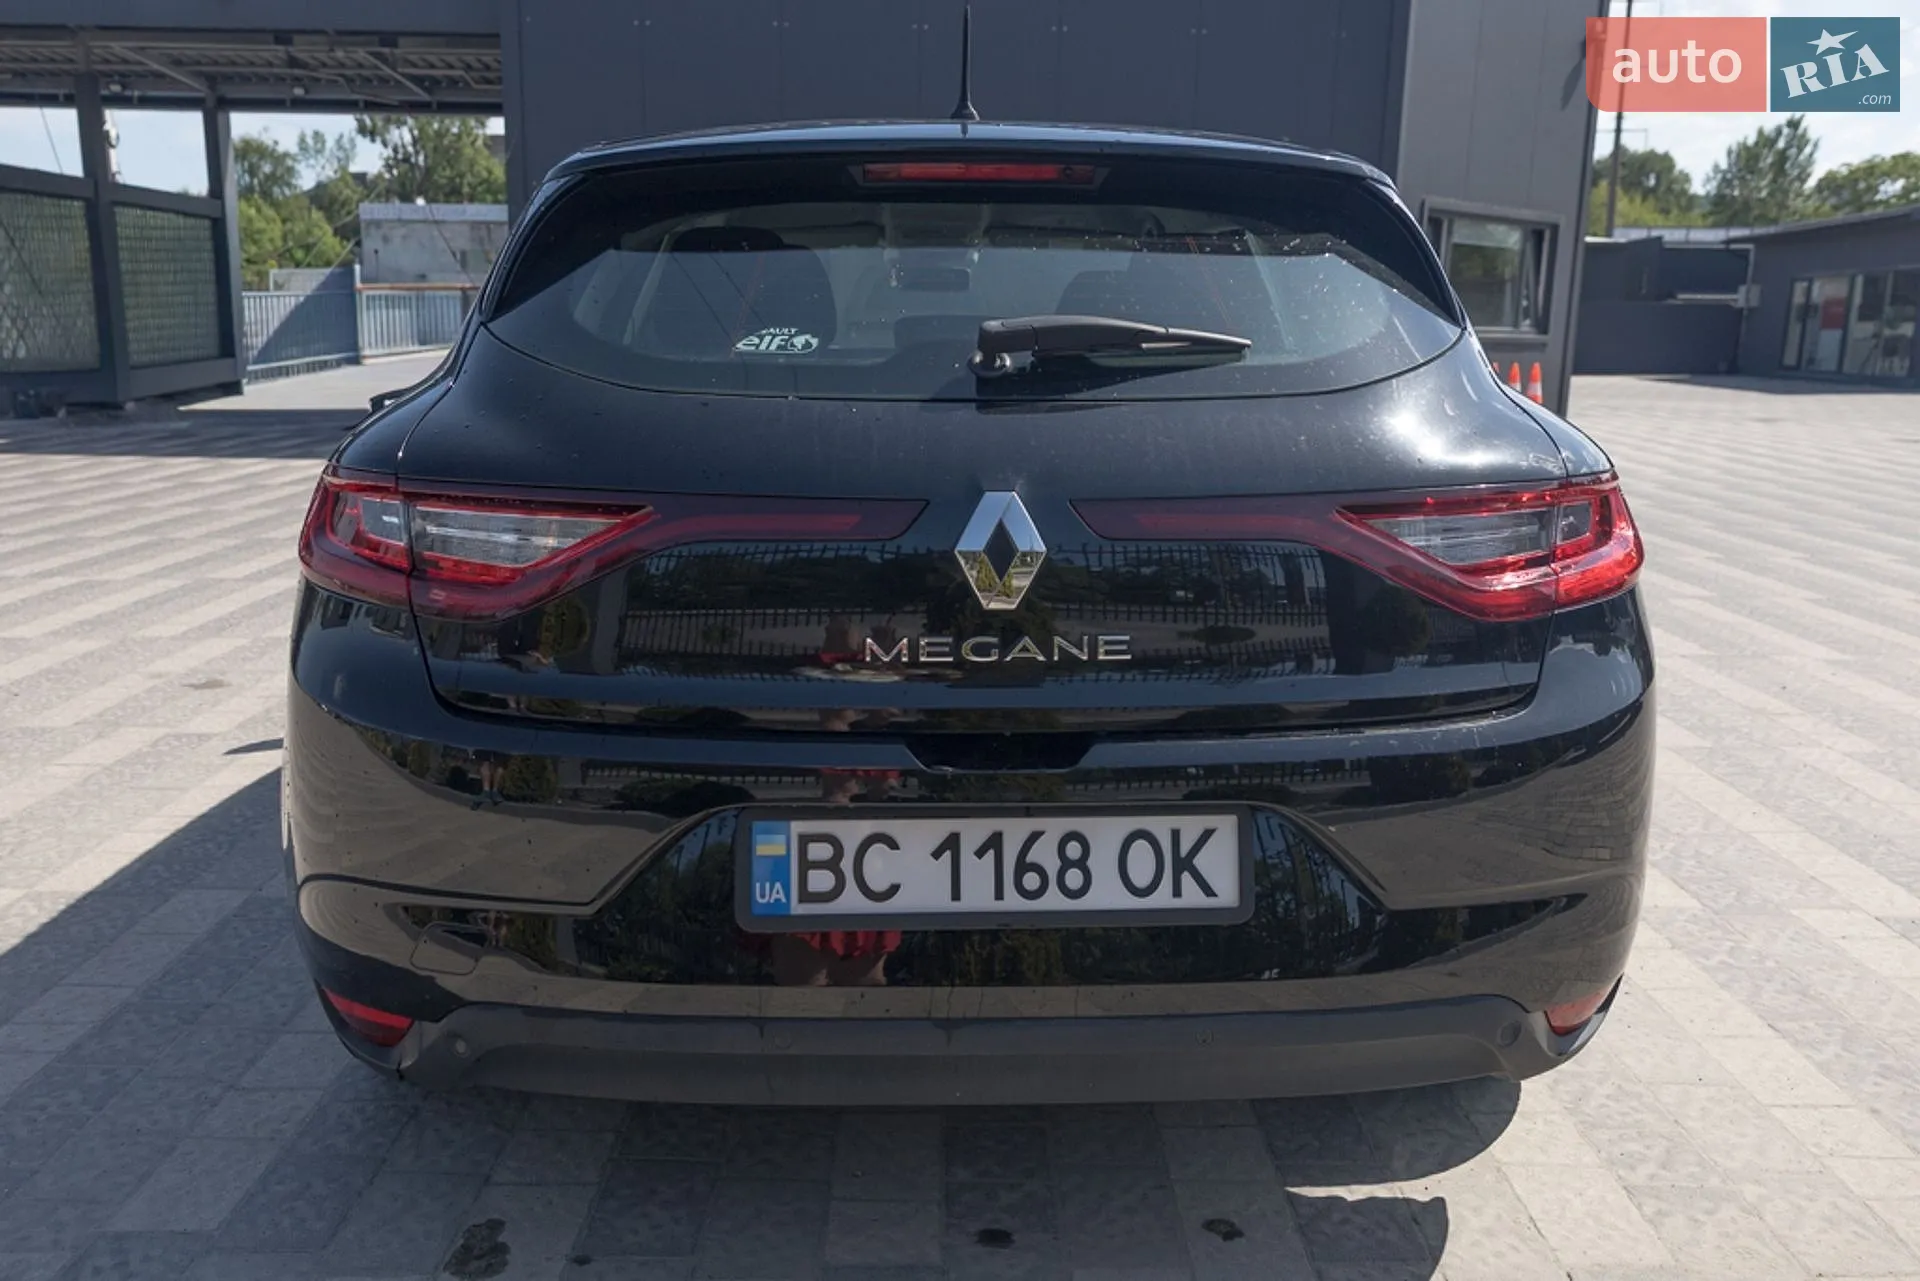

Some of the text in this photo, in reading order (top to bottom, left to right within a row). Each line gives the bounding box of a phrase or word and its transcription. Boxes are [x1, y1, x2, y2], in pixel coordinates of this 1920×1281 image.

[865, 635, 1133, 662] MEGANE
[797, 827, 1219, 904] BC 1168 OK
[755, 881, 787, 904] UA
